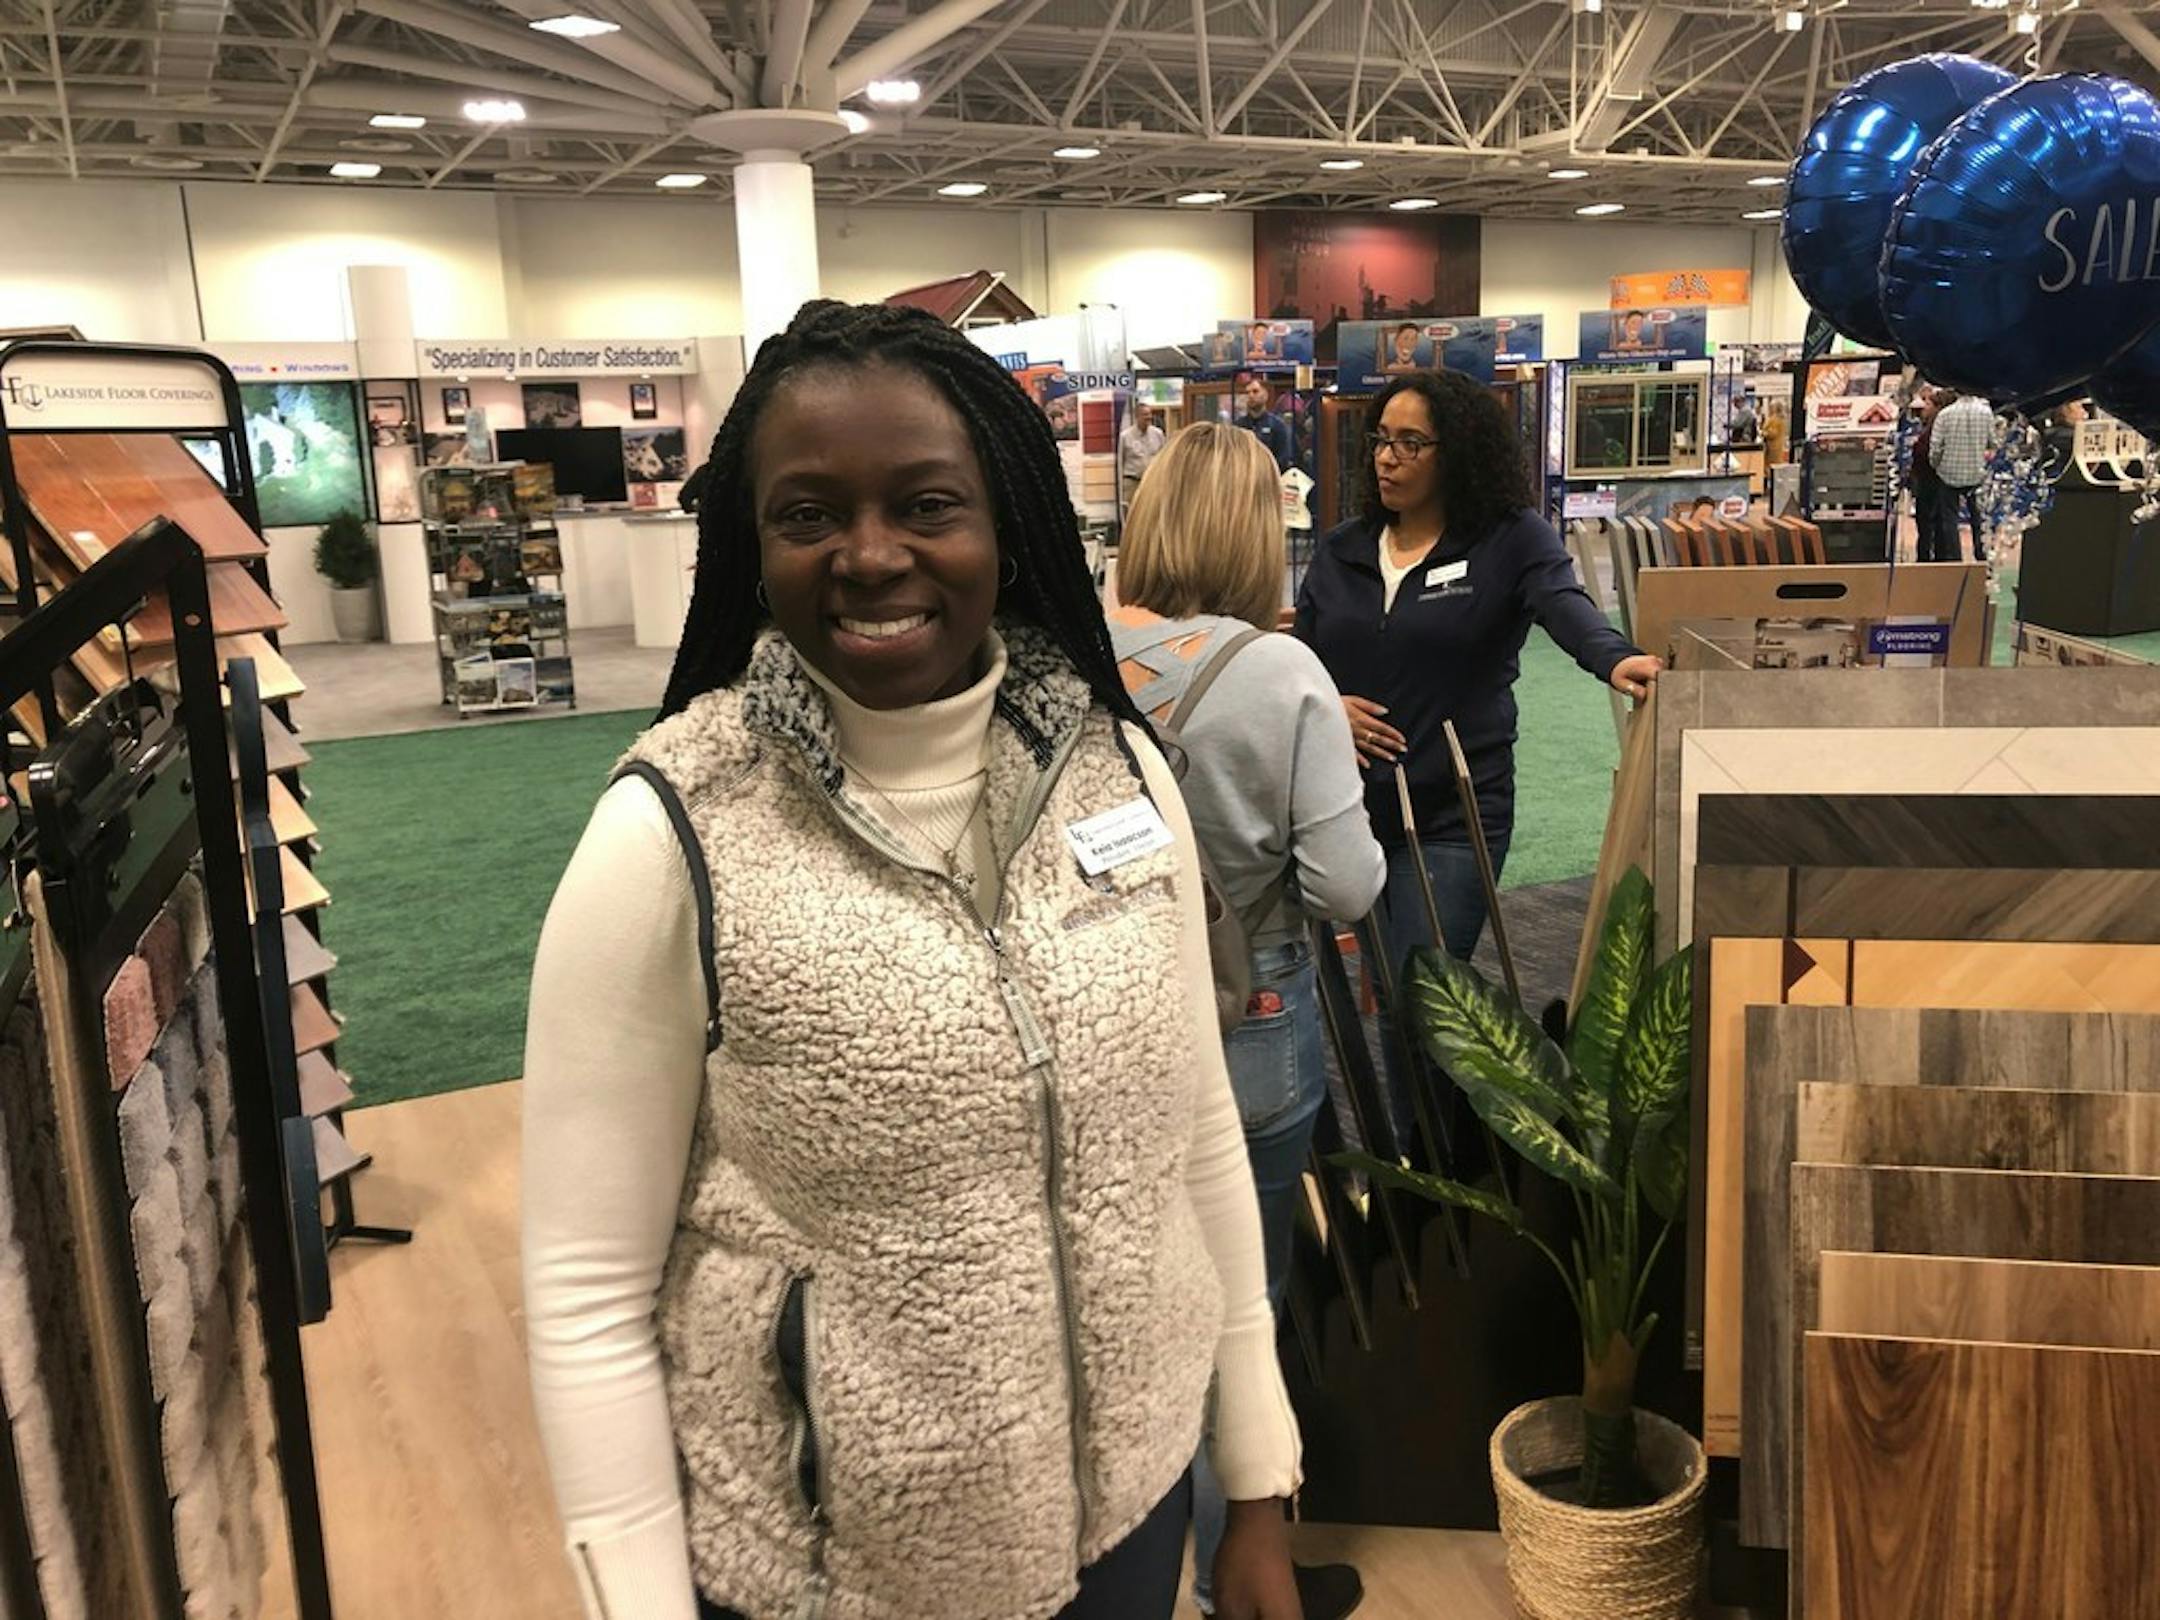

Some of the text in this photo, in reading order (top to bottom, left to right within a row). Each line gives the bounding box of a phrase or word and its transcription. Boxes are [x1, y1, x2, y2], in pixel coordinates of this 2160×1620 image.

[2038, 197, 2160, 293] SALE
[519, 347, 532, 368] in
[535, 346, 600, 368] Customer
[1068, 374, 1131, 390] SIDING
[45, 385, 215, 401] LAKESIDE FLOOR COVERINGS
